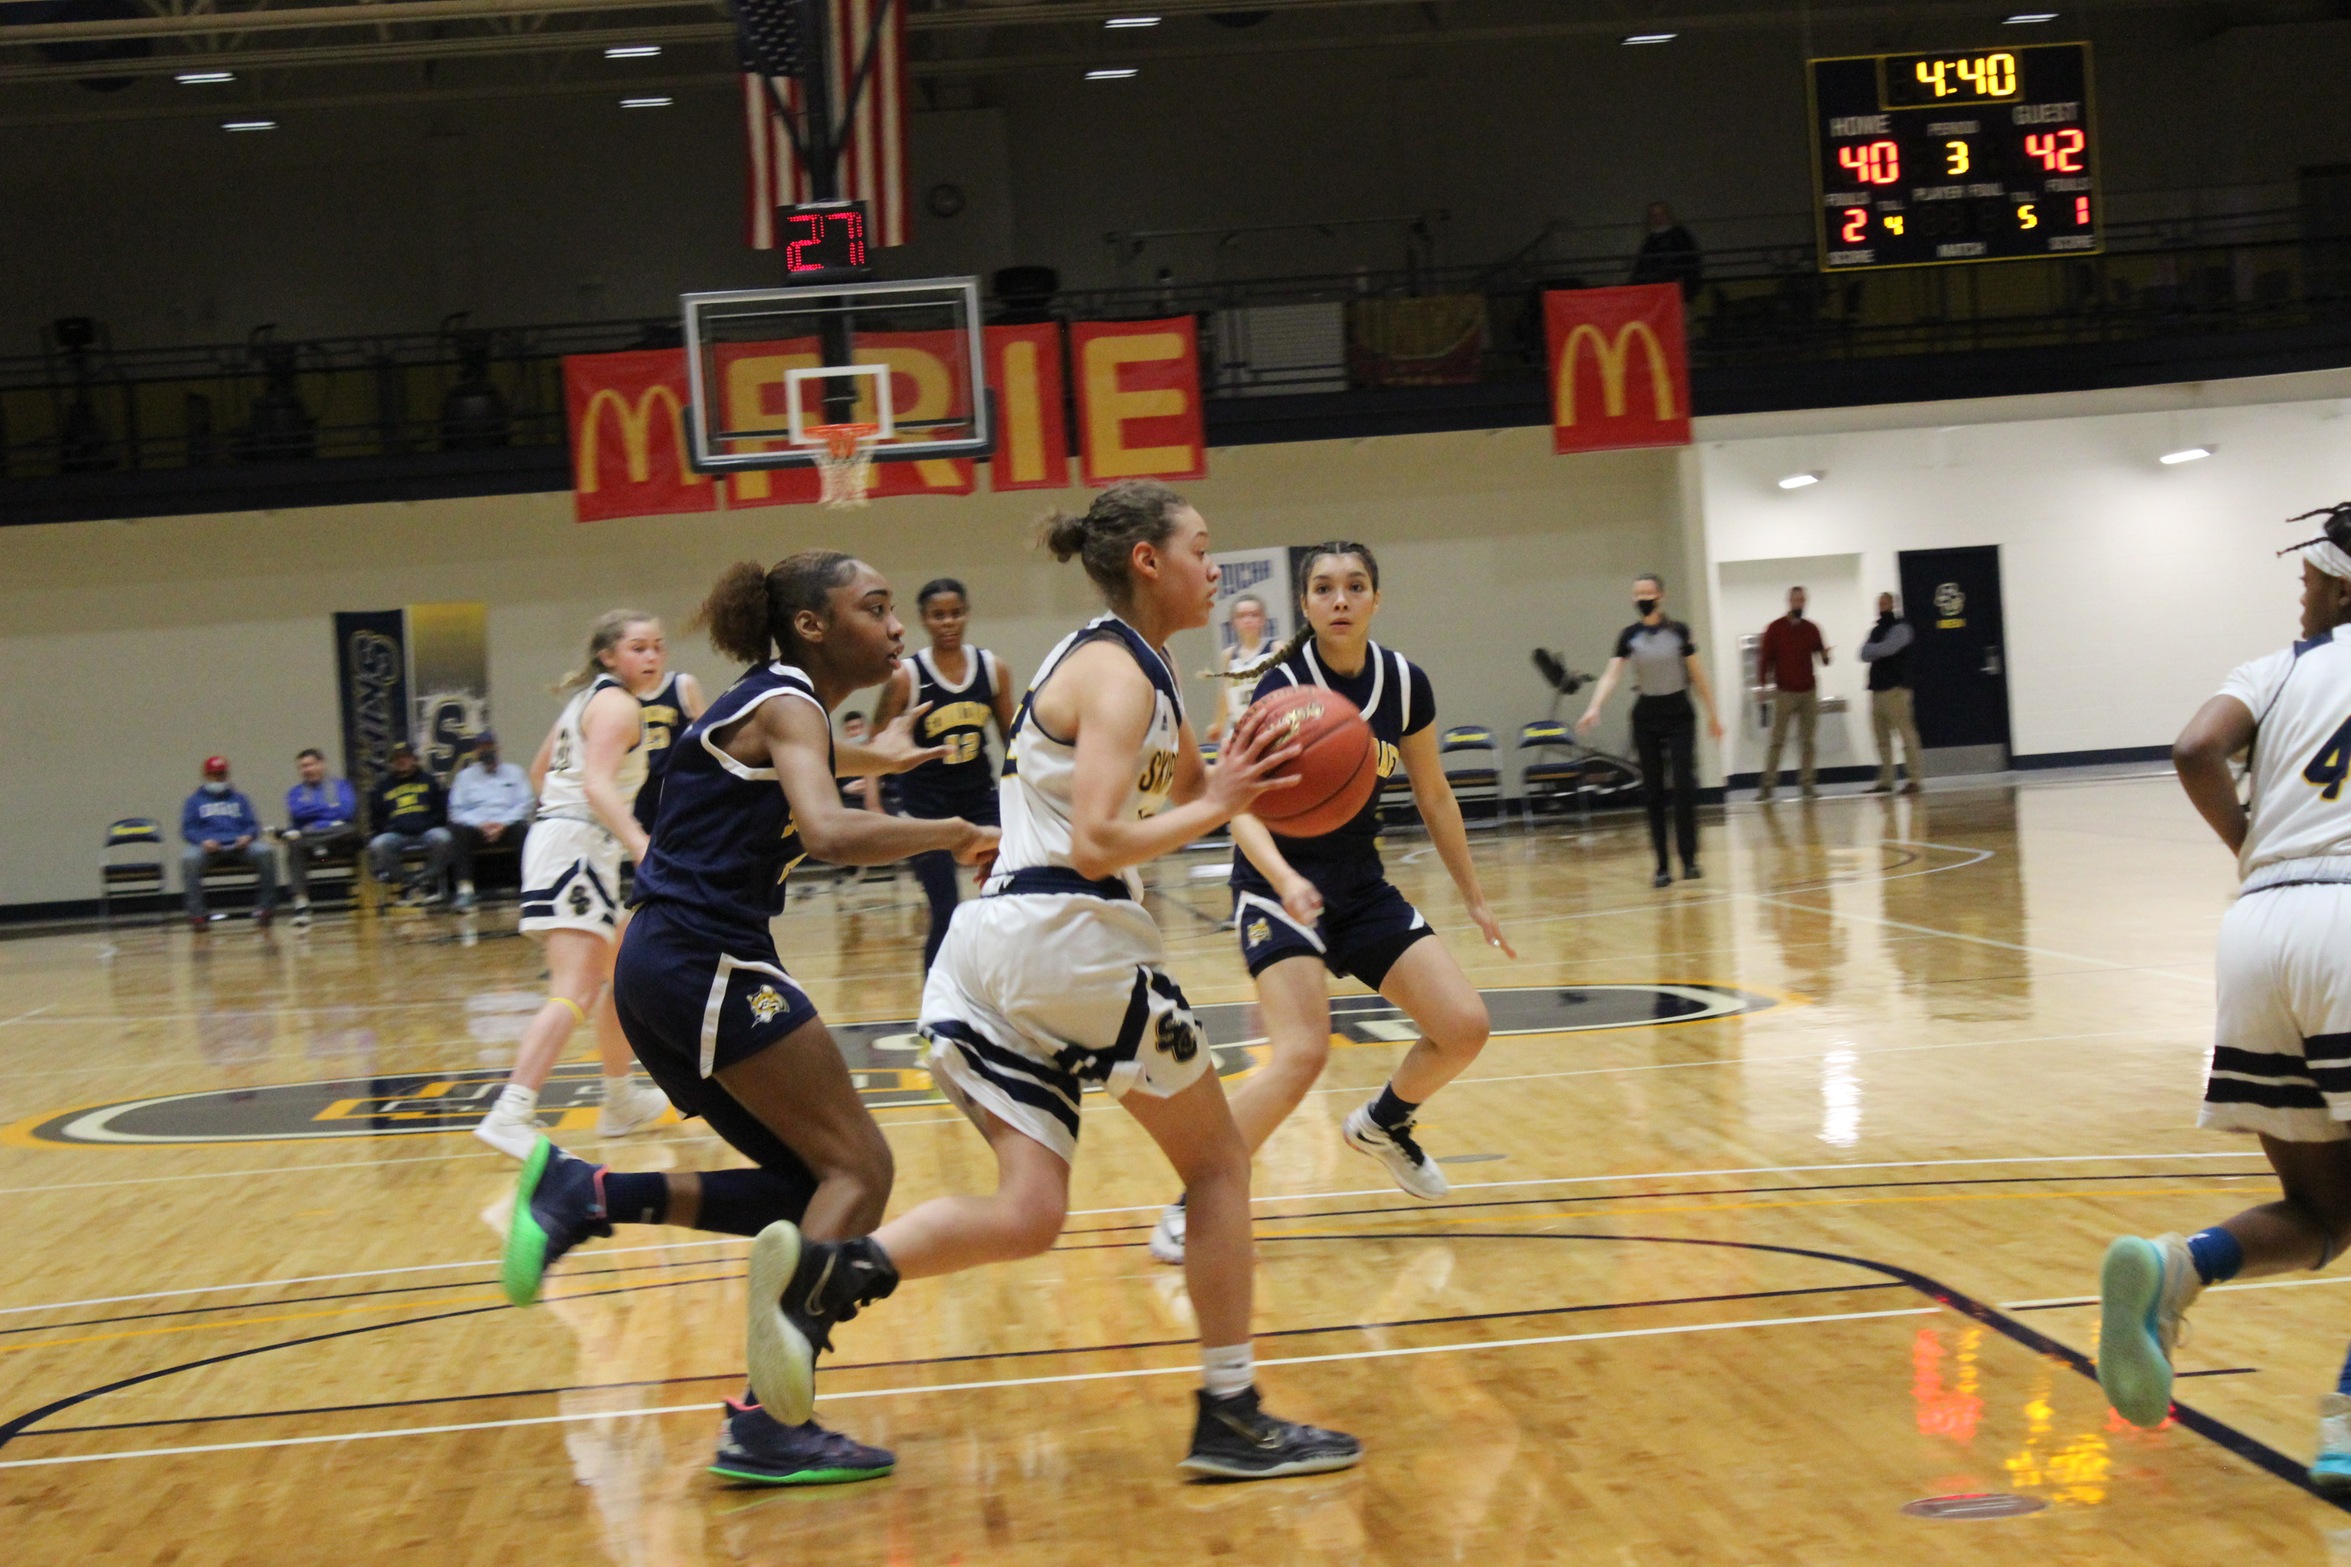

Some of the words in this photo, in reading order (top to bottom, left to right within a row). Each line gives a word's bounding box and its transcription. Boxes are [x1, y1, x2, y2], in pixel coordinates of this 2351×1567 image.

[1916, 53, 2016, 97] 4:40
[1829, 113, 1892, 137] HOME
[1838, 140, 1900, 184] 40
[1945, 141, 1970, 175] 3
[2024, 129, 2085, 172] 42
[1842, 208, 1868, 242] 2
[1883, 215, 1904, 235] 4
[2075, 196, 2090, 225] 1
[786, 210, 866, 272] 27
